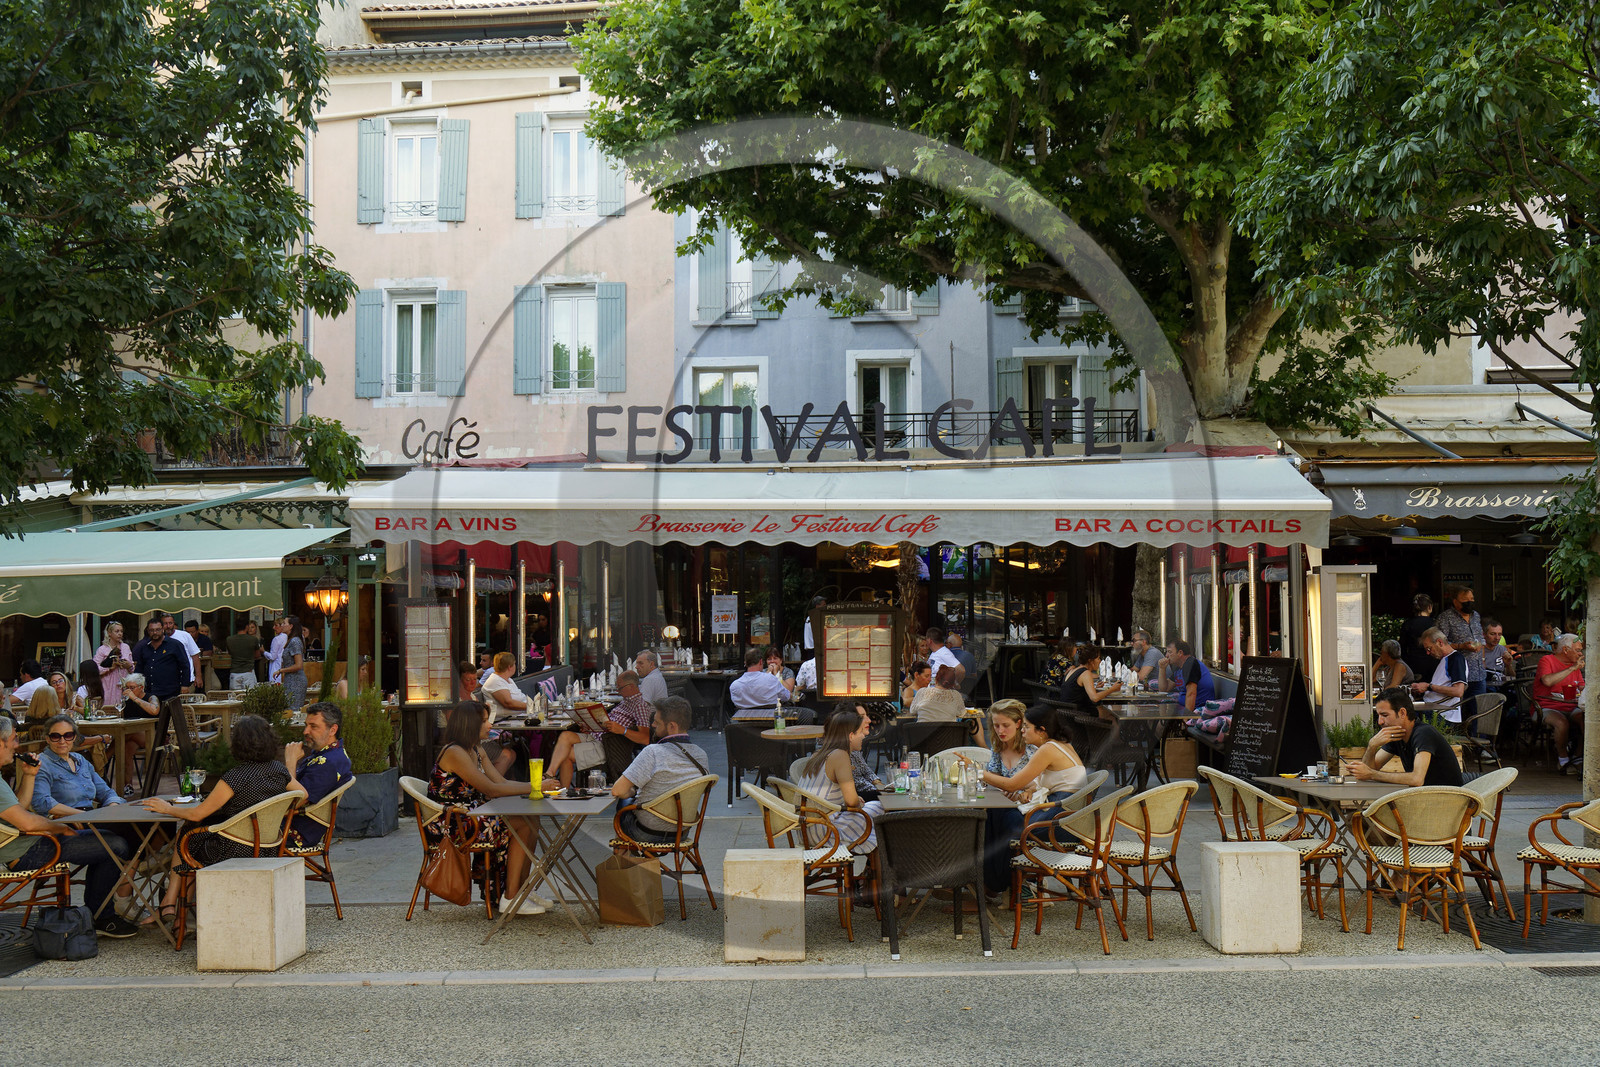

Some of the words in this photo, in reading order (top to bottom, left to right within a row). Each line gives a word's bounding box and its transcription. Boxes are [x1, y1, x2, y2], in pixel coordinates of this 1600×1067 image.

[402, 417, 480, 459] Café
[587, 400, 910, 464] FESTIVAL
[375, 517, 428, 531] BAR
[434, 517, 452, 531] A
[459, 517, 517, 531] VINS
[628, 513, 747, 533] Brasserie
[750, 514, 781, 533] Le
[784, 514, 887, 533] Festival
[884, 514, 941, 538] Café
[1055, 518, 1112, 532] BAR
[1119, 519, 1139, 533] A
[1146, 519, 1302, 533] COCKTAILS
[127, 576, 262, 601] Restaurant
